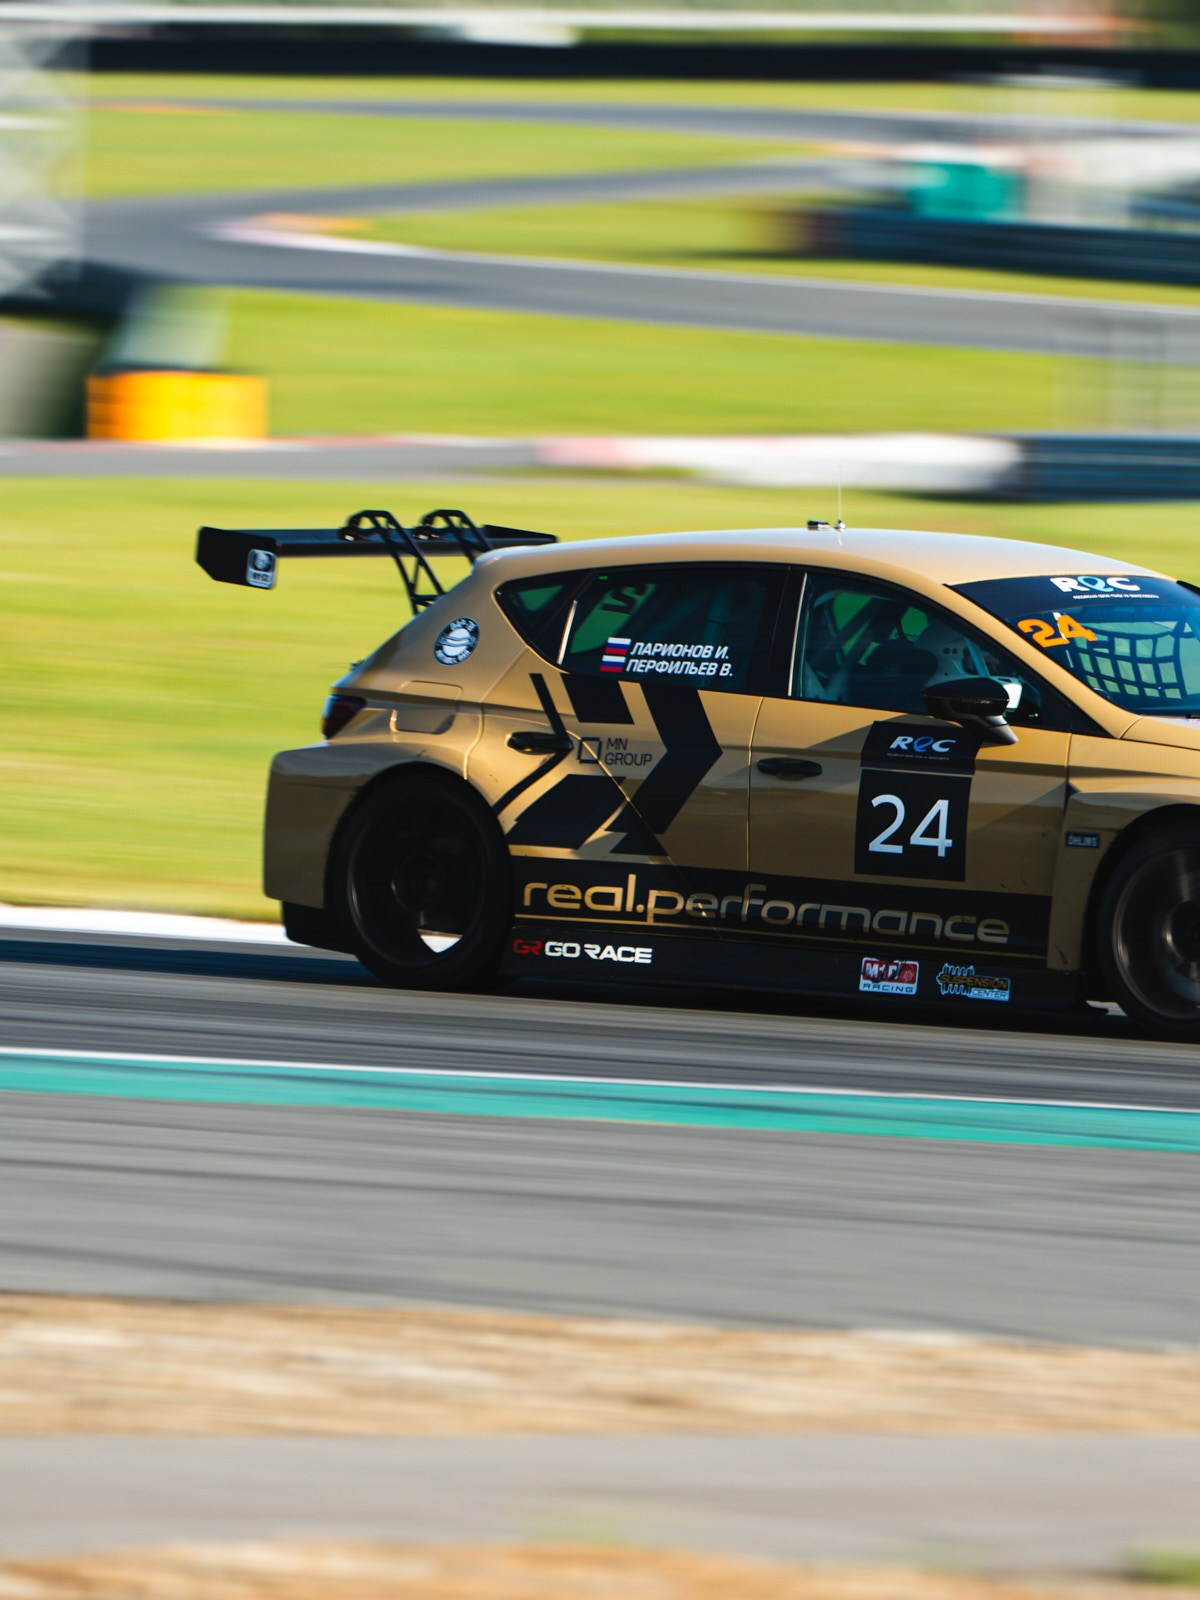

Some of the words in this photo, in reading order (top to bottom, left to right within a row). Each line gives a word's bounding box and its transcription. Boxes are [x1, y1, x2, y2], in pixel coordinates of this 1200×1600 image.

[1017, 614, 1098, 648] 24
[630, 642, 714, 659] ЛАРИОНОВ
[714, 646, 729, 660] И.
[626, 659, 718, 676] ПЕРФИЛЬЕВ
[719, 663, 733, 677] В.
[606, 737, 628, 750] MN
[604, 752, 653, 766] GROUP
[868, 794, 953, 857] 24
[523, 873, 1010, 944] real.performance
[544, 941, 581, 958] GO
[583, 943, 653, 964] RACE
[863, 983, 914, 993] RACING
[940, 974, 1008, 989] SUSPENSION
[972, 988, 1006, 999] CENTER
